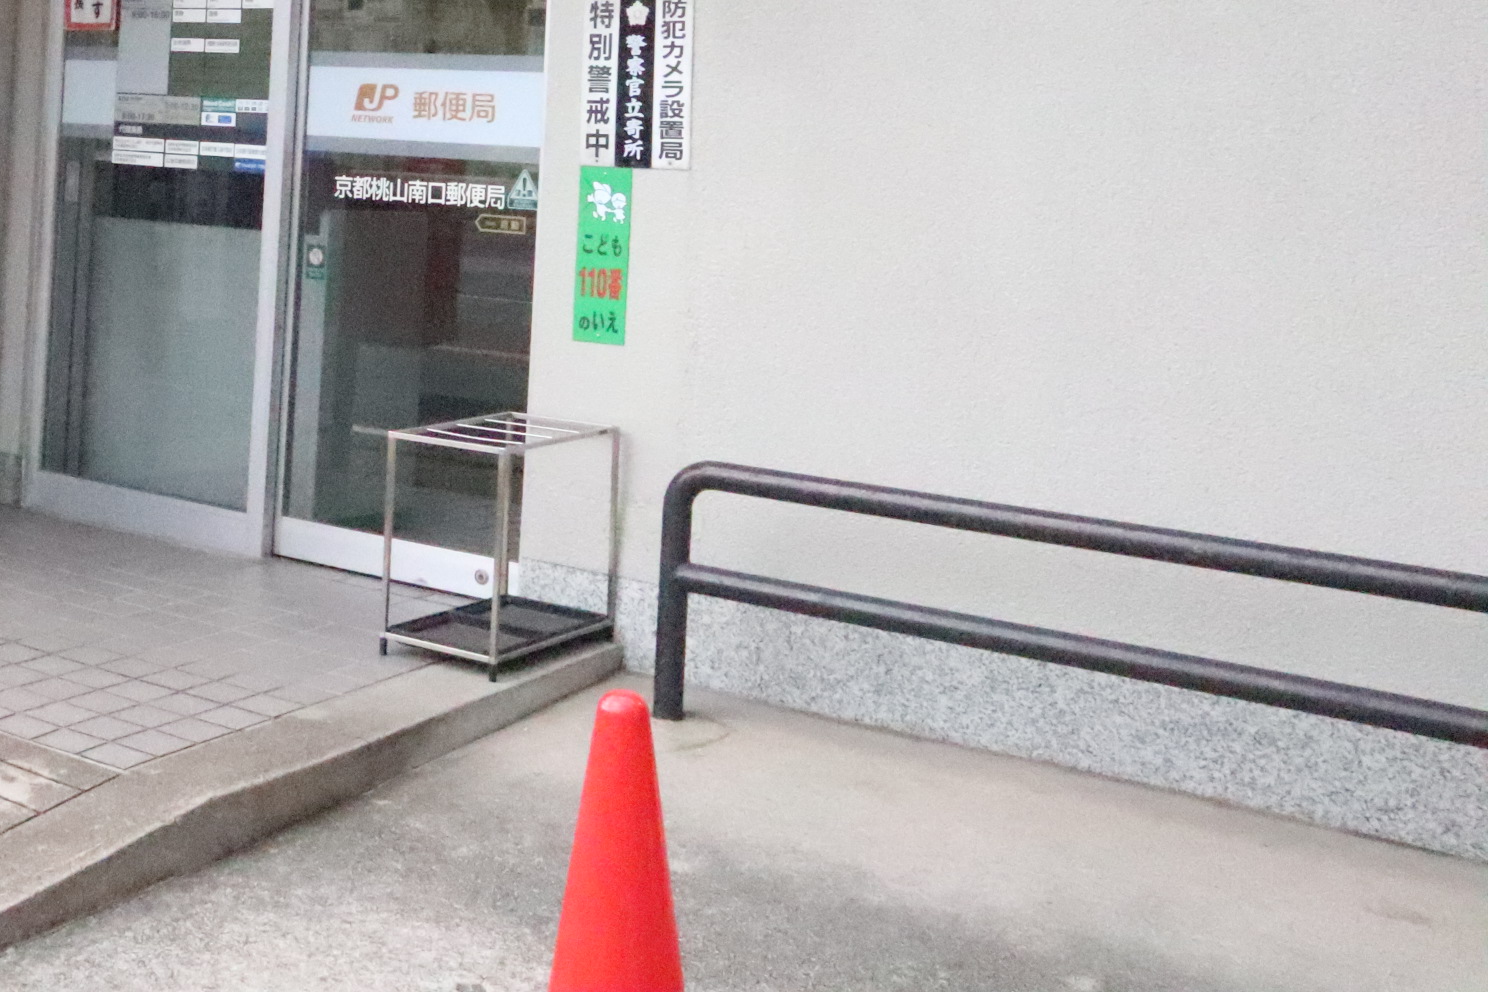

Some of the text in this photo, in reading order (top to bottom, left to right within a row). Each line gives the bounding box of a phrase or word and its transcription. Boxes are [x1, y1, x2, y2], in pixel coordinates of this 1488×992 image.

[585, 0, 614, 158] 特別警戒中
[354, 83, 496, 124] JP 郵便局
[623, 34, 647, 160] 警察官立寄所
[351, 114, 394, 124] NETWORK
[334, 175, 505, 210] 京都桃山南口郵便局
[582, 233, 622, 257] こども
[579, 267, 622, 301] 110番
[578, 311, 618, 334] のいえ
